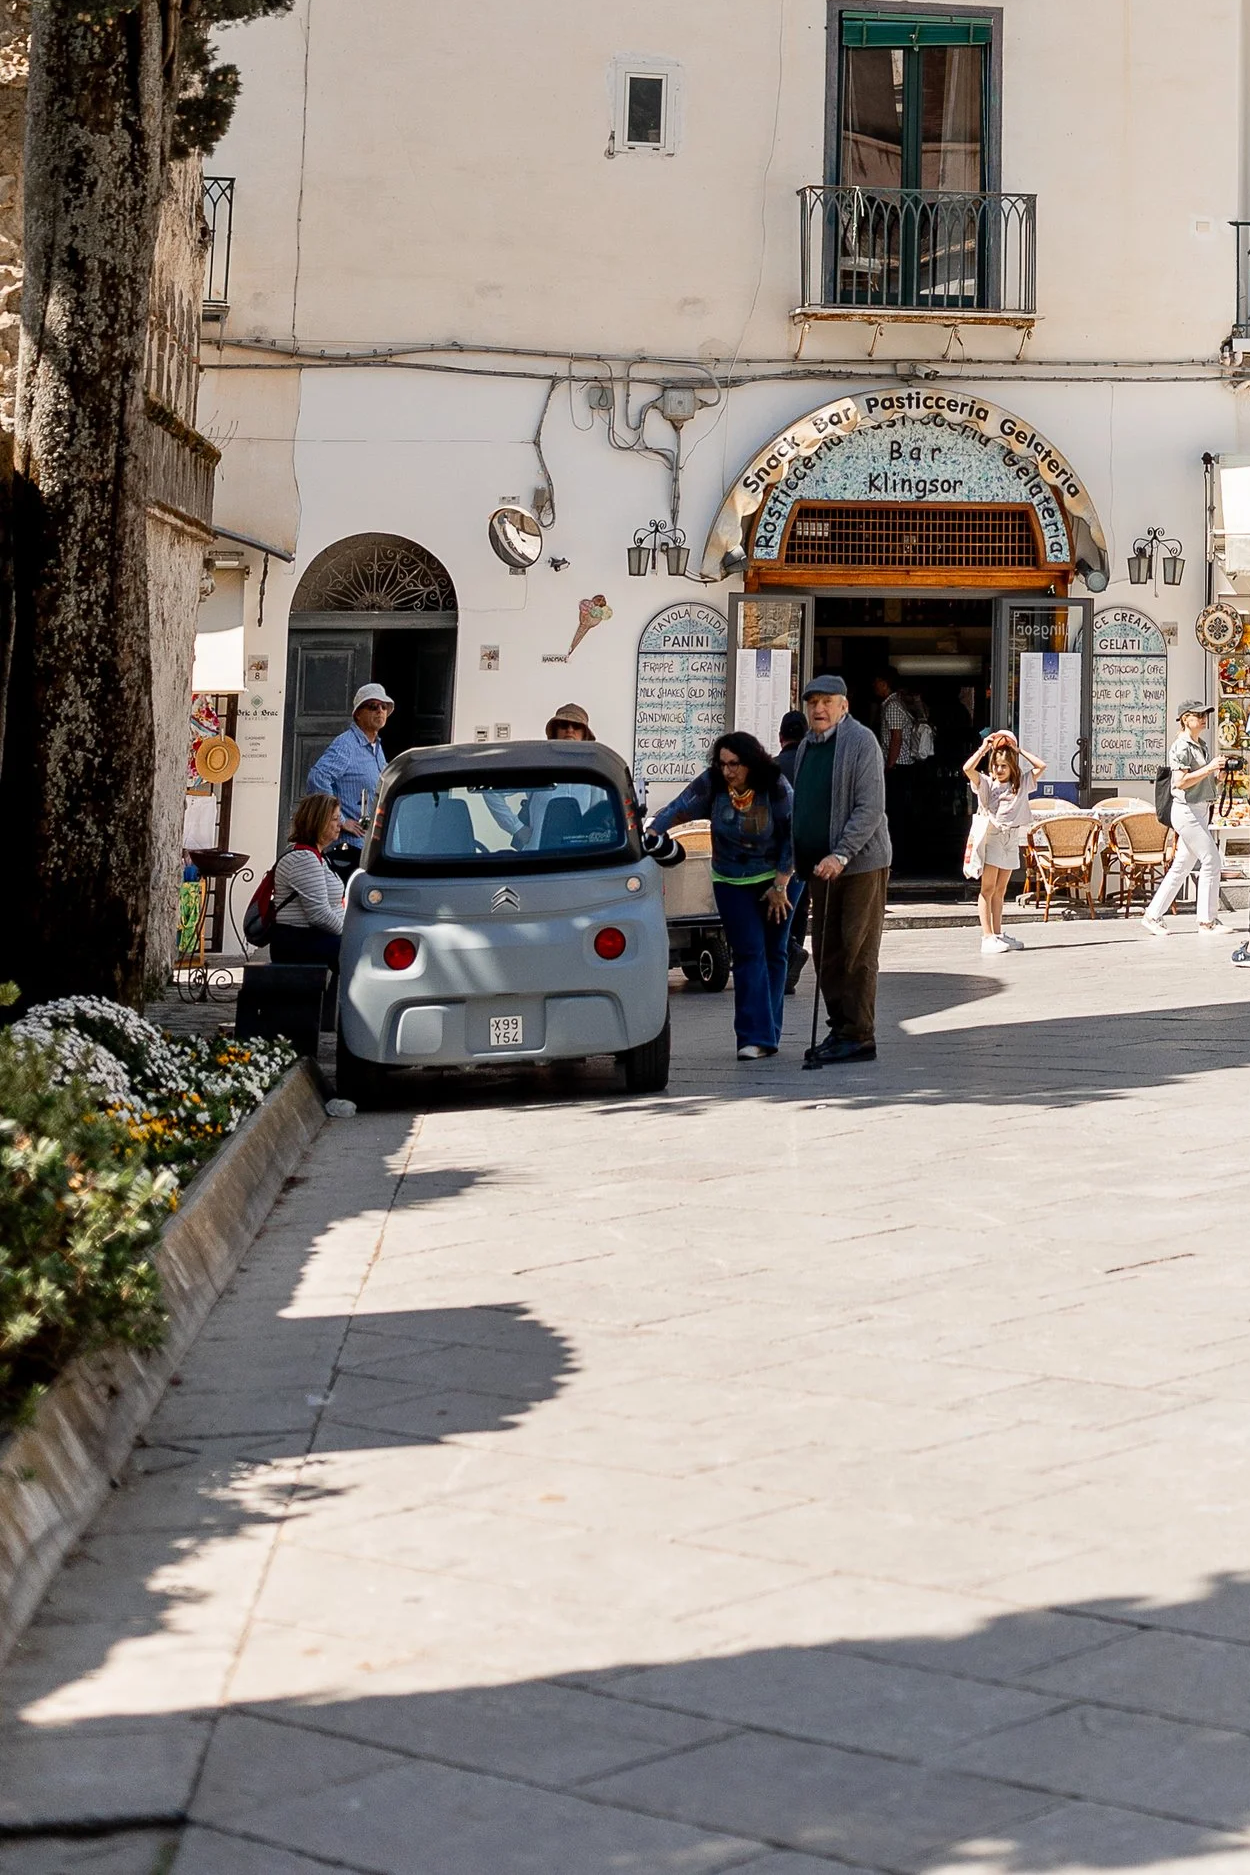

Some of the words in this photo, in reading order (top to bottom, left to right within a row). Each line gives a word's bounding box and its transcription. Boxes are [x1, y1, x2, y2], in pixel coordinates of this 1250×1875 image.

[742, 435, 800, 494] Snack
[812, 405, 853, 435] Bar
[865, 392, 989, 423] Pasticceria
[999, 417, 1080, 498] Gelateria
[890, 440, 942, 462] Bar
[868, 472, 963, 500] Klingsor
[755, 435, 844, 549] Rosticceria
[1002, 451, 1062, 555] Gelateria
[652, 609, 691, 634] TAVOLA
[696, 610, 726, 635] CALDA
[1114, 612, 1151, 634] CREAM
[663, 635, 709, 647] PANINI
[1099, 638, 1141, 650] GELATI
[691, 661, 728, 673] GRANI
[255, 672, 260, 680] 8
[657, 687, 685, 699] SHAKES
[687, 687, 705, 699] COLD
[637, 711, 685, 723] SANDWICHES
[697, 712, 726, 724] CAKES
[637, 738, 650, 748] ICE
[652, 738, 677, 749] CREAM
[646, 762, 696, 775] COCKTAILS
[494, 1018, 518, 1031] X99
[495, 1031, 518, 1044] Y54
